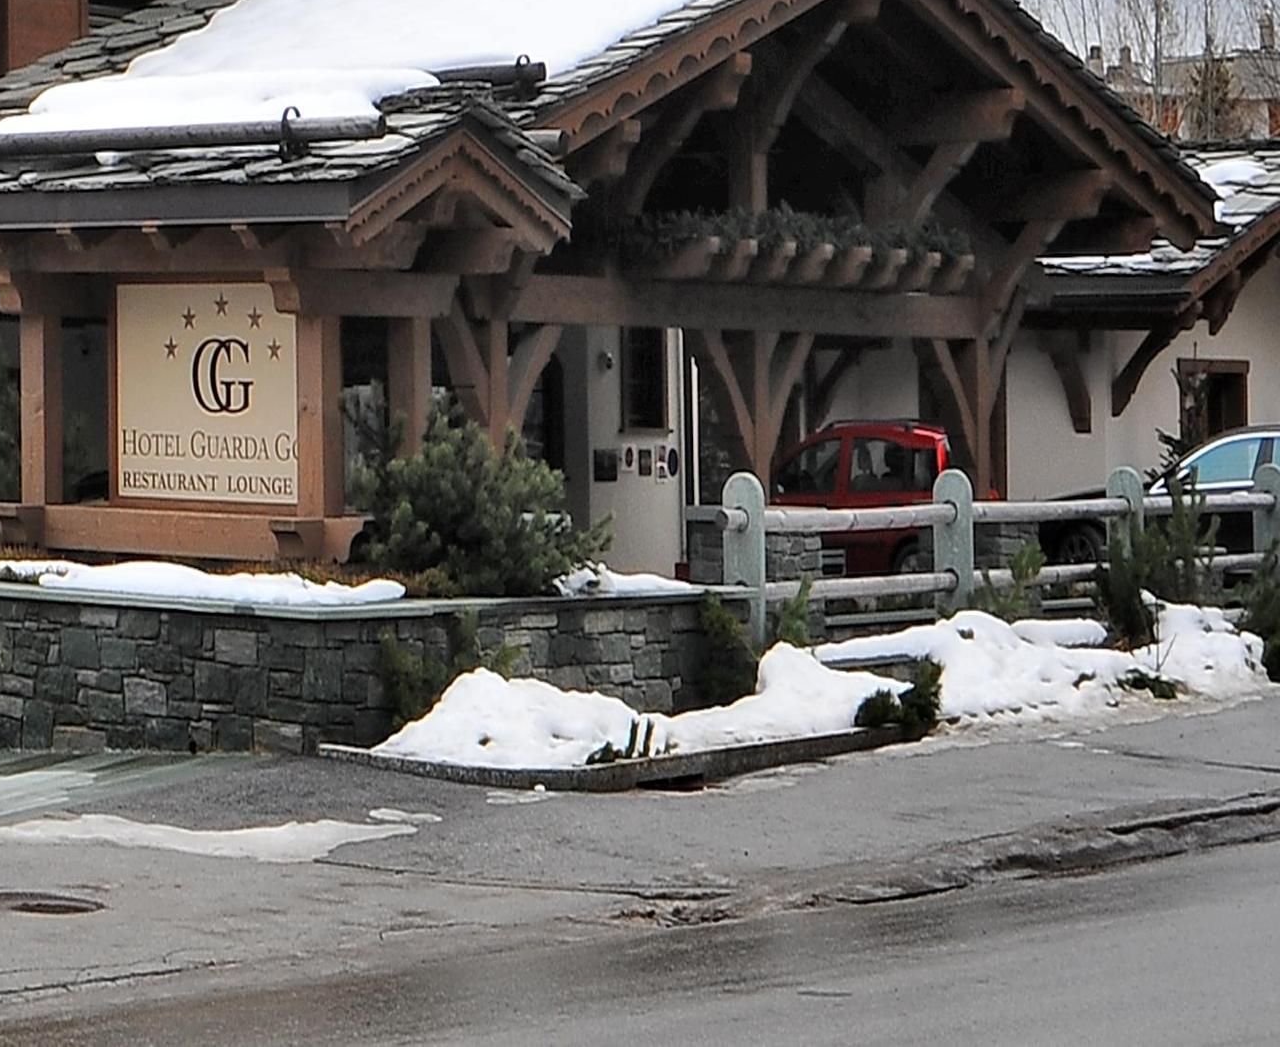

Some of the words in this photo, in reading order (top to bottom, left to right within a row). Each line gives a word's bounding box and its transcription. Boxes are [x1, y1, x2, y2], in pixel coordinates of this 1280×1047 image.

[122, 429, 185, 456] HOTEL
[190, 430, 269, 460] GUARDA
[123, 471, 218, 491] RESTAURANT
[228, 475, 292, 495] LOUNGE
